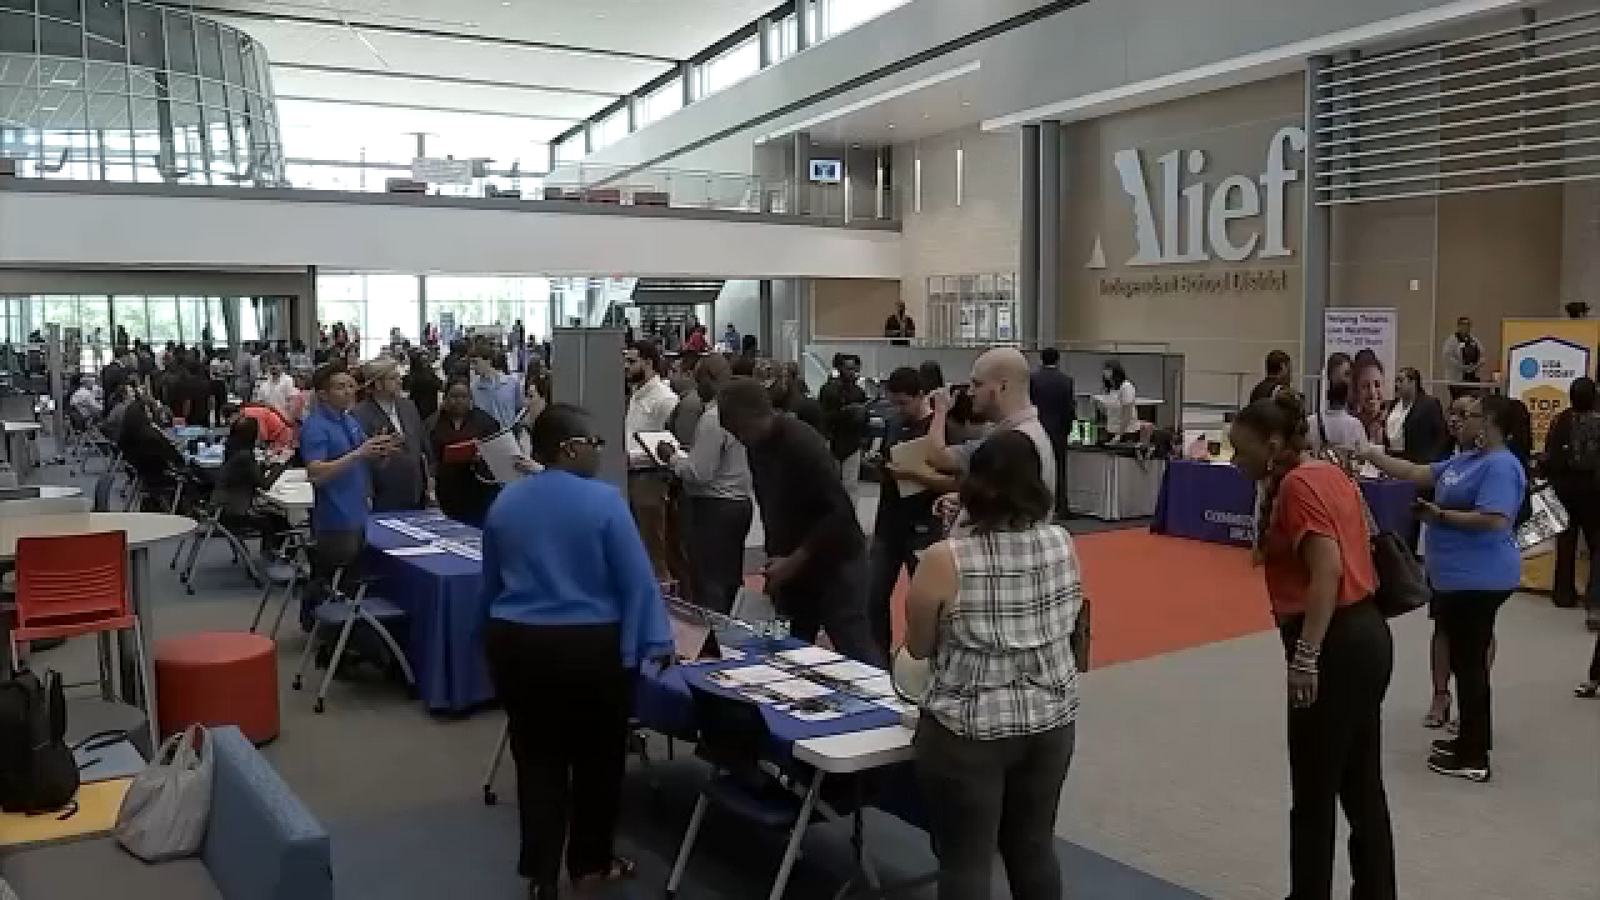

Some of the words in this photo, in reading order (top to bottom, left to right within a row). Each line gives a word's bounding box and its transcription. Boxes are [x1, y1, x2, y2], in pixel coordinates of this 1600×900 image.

[1085, 126, 1305, 269] Alief
[1099, 274, 1178, 299] Independent
[1180, 271, 1231, 294] School
[1233, 269, 1287, 291] District
[1542, 369, 1576, 378] TODAY
[1529, 397, 1561, 411] TOP
